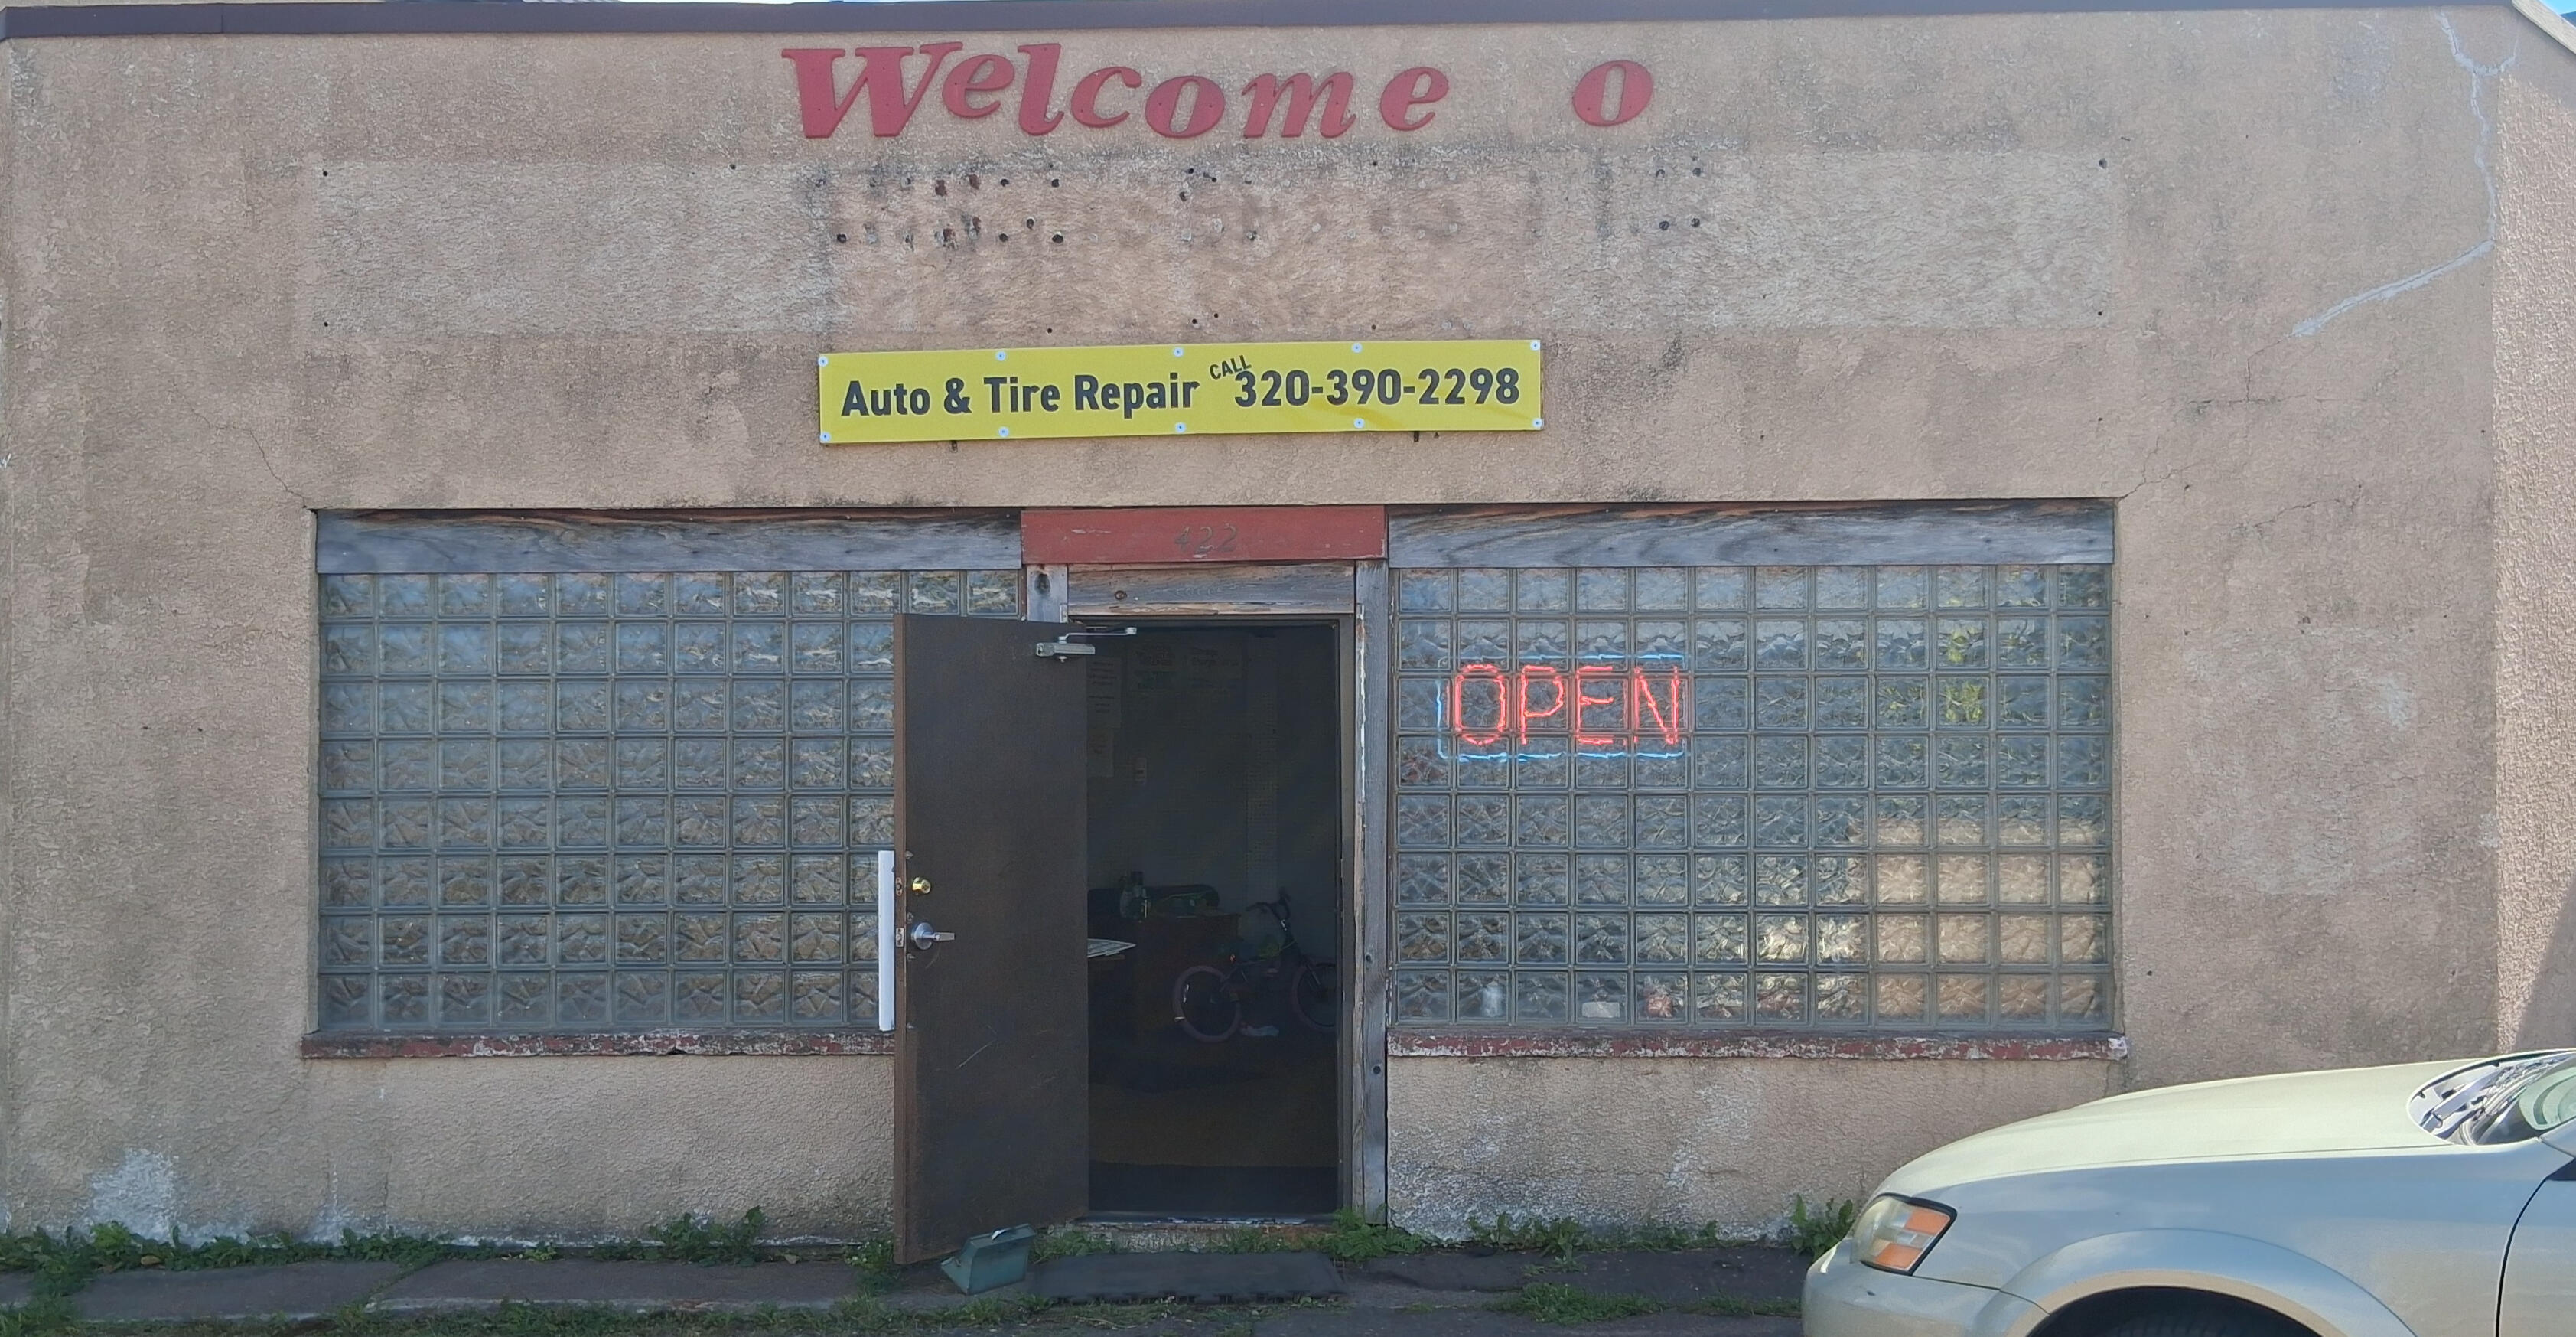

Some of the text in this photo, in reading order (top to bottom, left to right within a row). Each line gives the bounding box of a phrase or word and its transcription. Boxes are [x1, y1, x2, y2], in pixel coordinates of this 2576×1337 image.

[781, 41, 1654, 139] Welcome o
[841, 354, 1520, 419] Auto & Tire Repair CALL 320-390-2298
[1174, 523, 1239, 554] 422
[1454, 663, 1680, 746] OPEN
